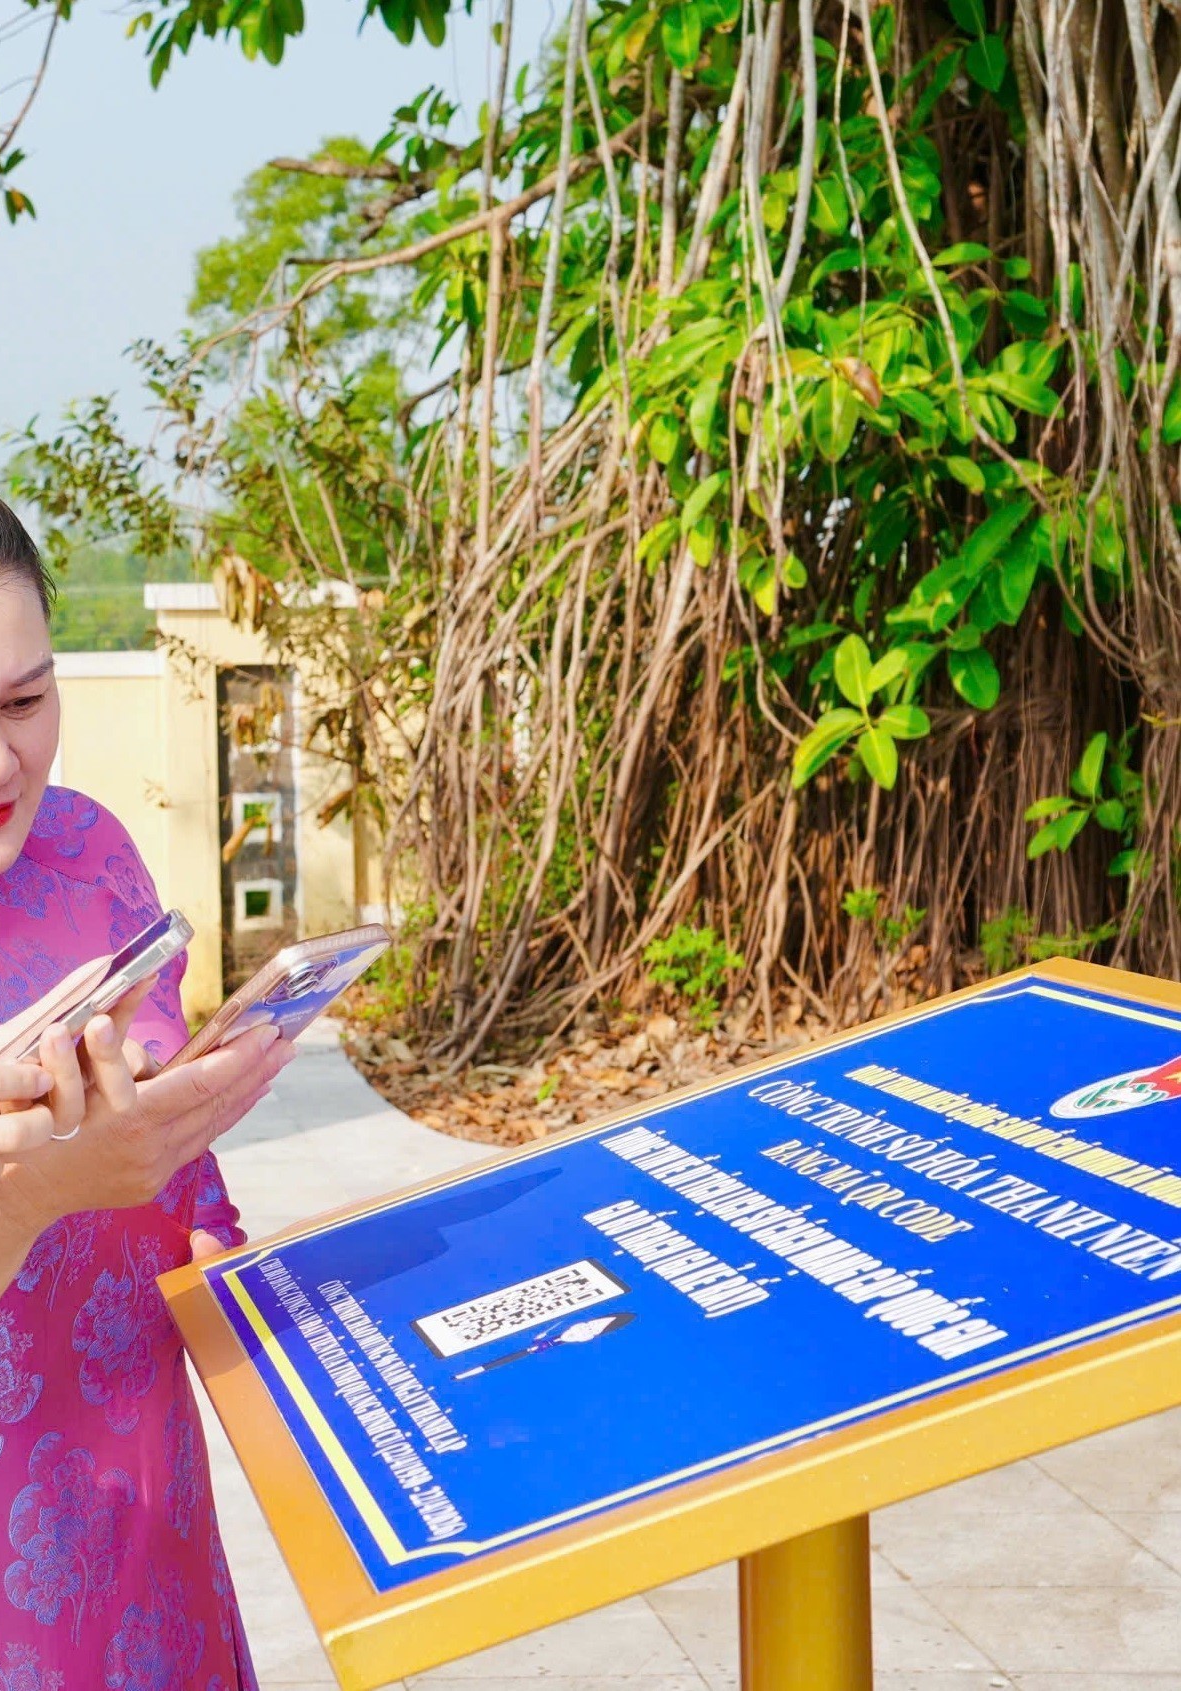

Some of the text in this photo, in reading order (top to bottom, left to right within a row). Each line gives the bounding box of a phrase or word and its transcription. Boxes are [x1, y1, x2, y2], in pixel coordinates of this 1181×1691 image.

[748, 1080, 836, 1116] CÔNG
[802, 1102, 907, 1148] TRÌNH
[869, 1134, 952, 1161] SỐ
[760, 1139, 974, 1243] BẢNG MÃ QR CODE
[903, 1148, 996, 1191] HÓA
[965, 1174, 1116, 1240] THANH
[1071, 1223, 1181, 1280] NIÊN
